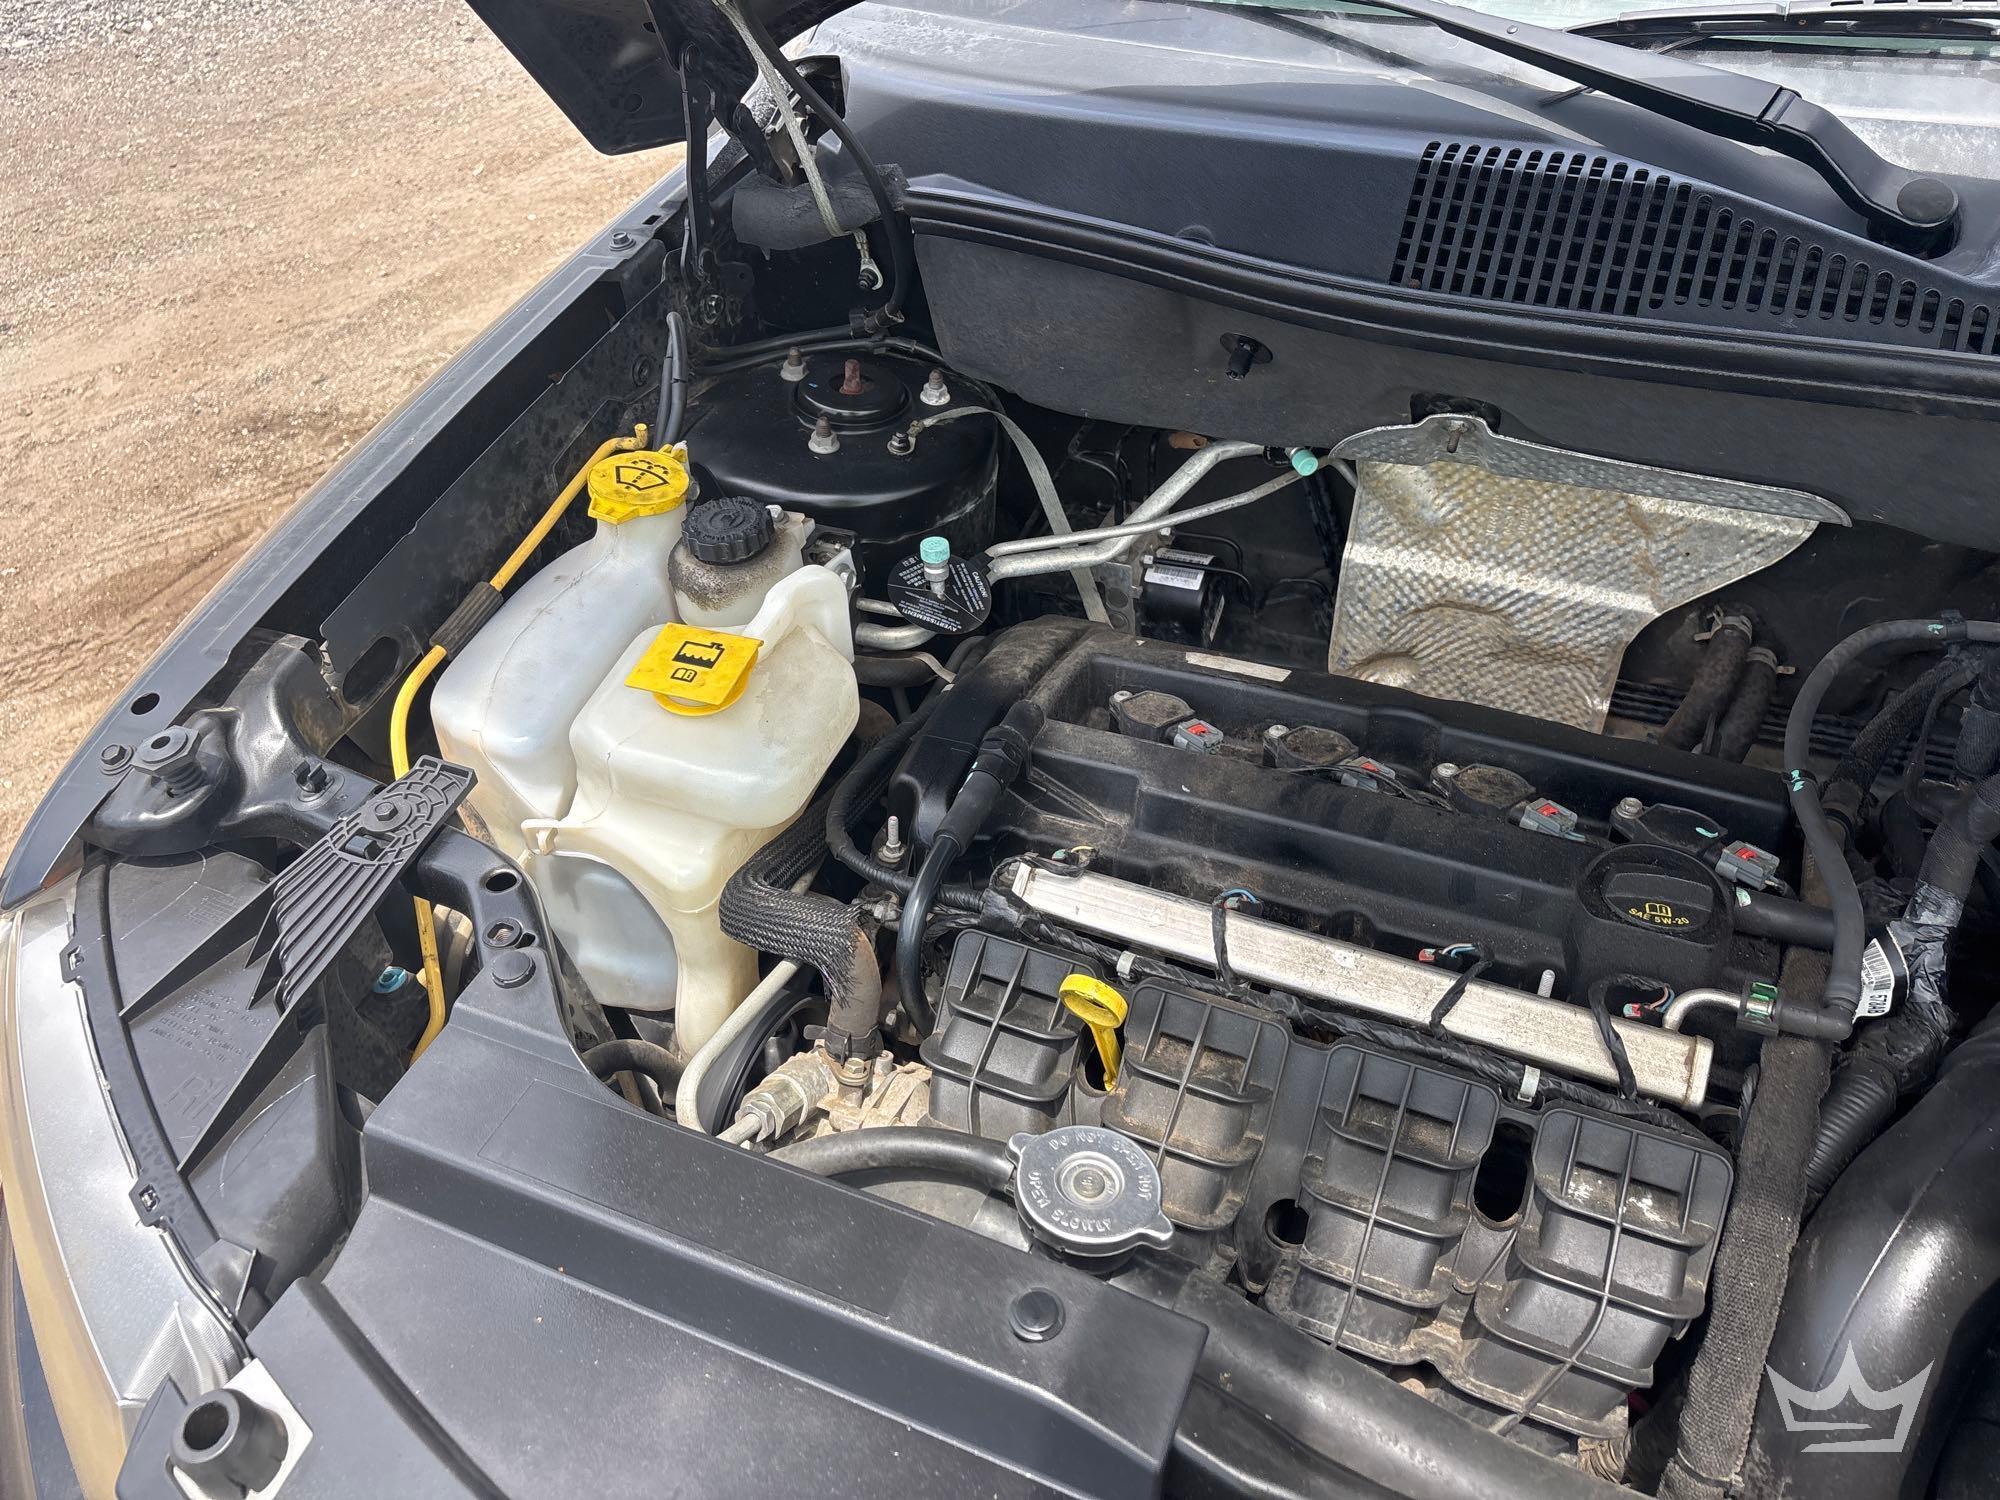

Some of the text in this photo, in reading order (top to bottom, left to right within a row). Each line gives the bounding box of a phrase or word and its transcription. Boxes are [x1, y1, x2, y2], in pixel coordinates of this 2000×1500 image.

[1628, 908, 1690, 925] SAE 5W-20
[1048, 1135, 1070, 1151] DO
[1075, 1131, 1106, 1144] NOT
[1111, 1139, 1146, 1171] OPEN
[1028, 1169, 1113, 1233] OPEN SLOWLY
